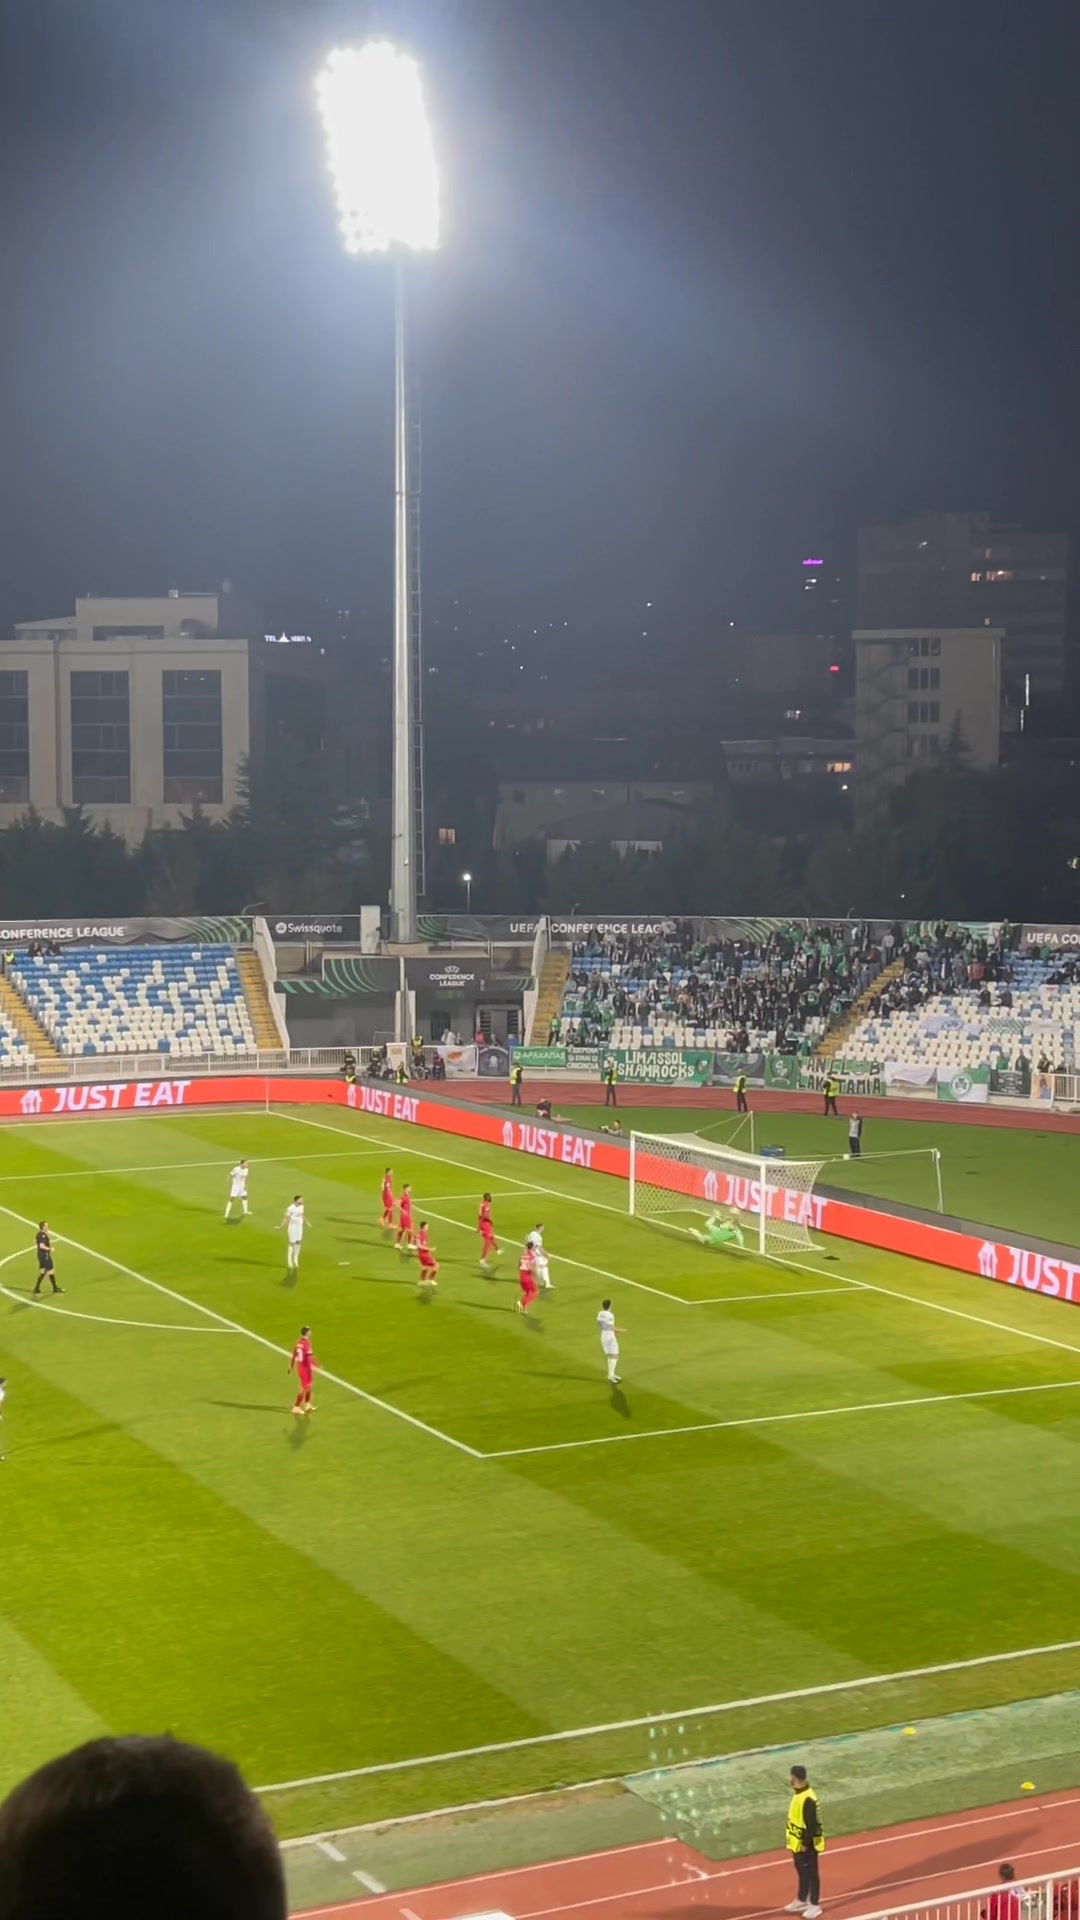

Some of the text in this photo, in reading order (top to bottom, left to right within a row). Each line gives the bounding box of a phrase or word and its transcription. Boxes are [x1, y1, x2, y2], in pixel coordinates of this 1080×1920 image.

[0, 926, 125, 940] ONFERENCE LEAGUE
[288, 922, 343, 935] Swissquote
[1026, 932, 1080, 945] UEFA CO
[617, 1062, 695, 1078] SHAMROCKS
[624, 1050, 687, 1066] LIMASSOL
[52, 1080, 192, 1112] JUST EAT
[360, 1086, 420, 1122] JUST EAT
[518, 1123, 595, 1168] JUST EAT
[724, 1174, 828, 1230] JUST EAT
[1007, 1246, 1080, 1301] JUST
